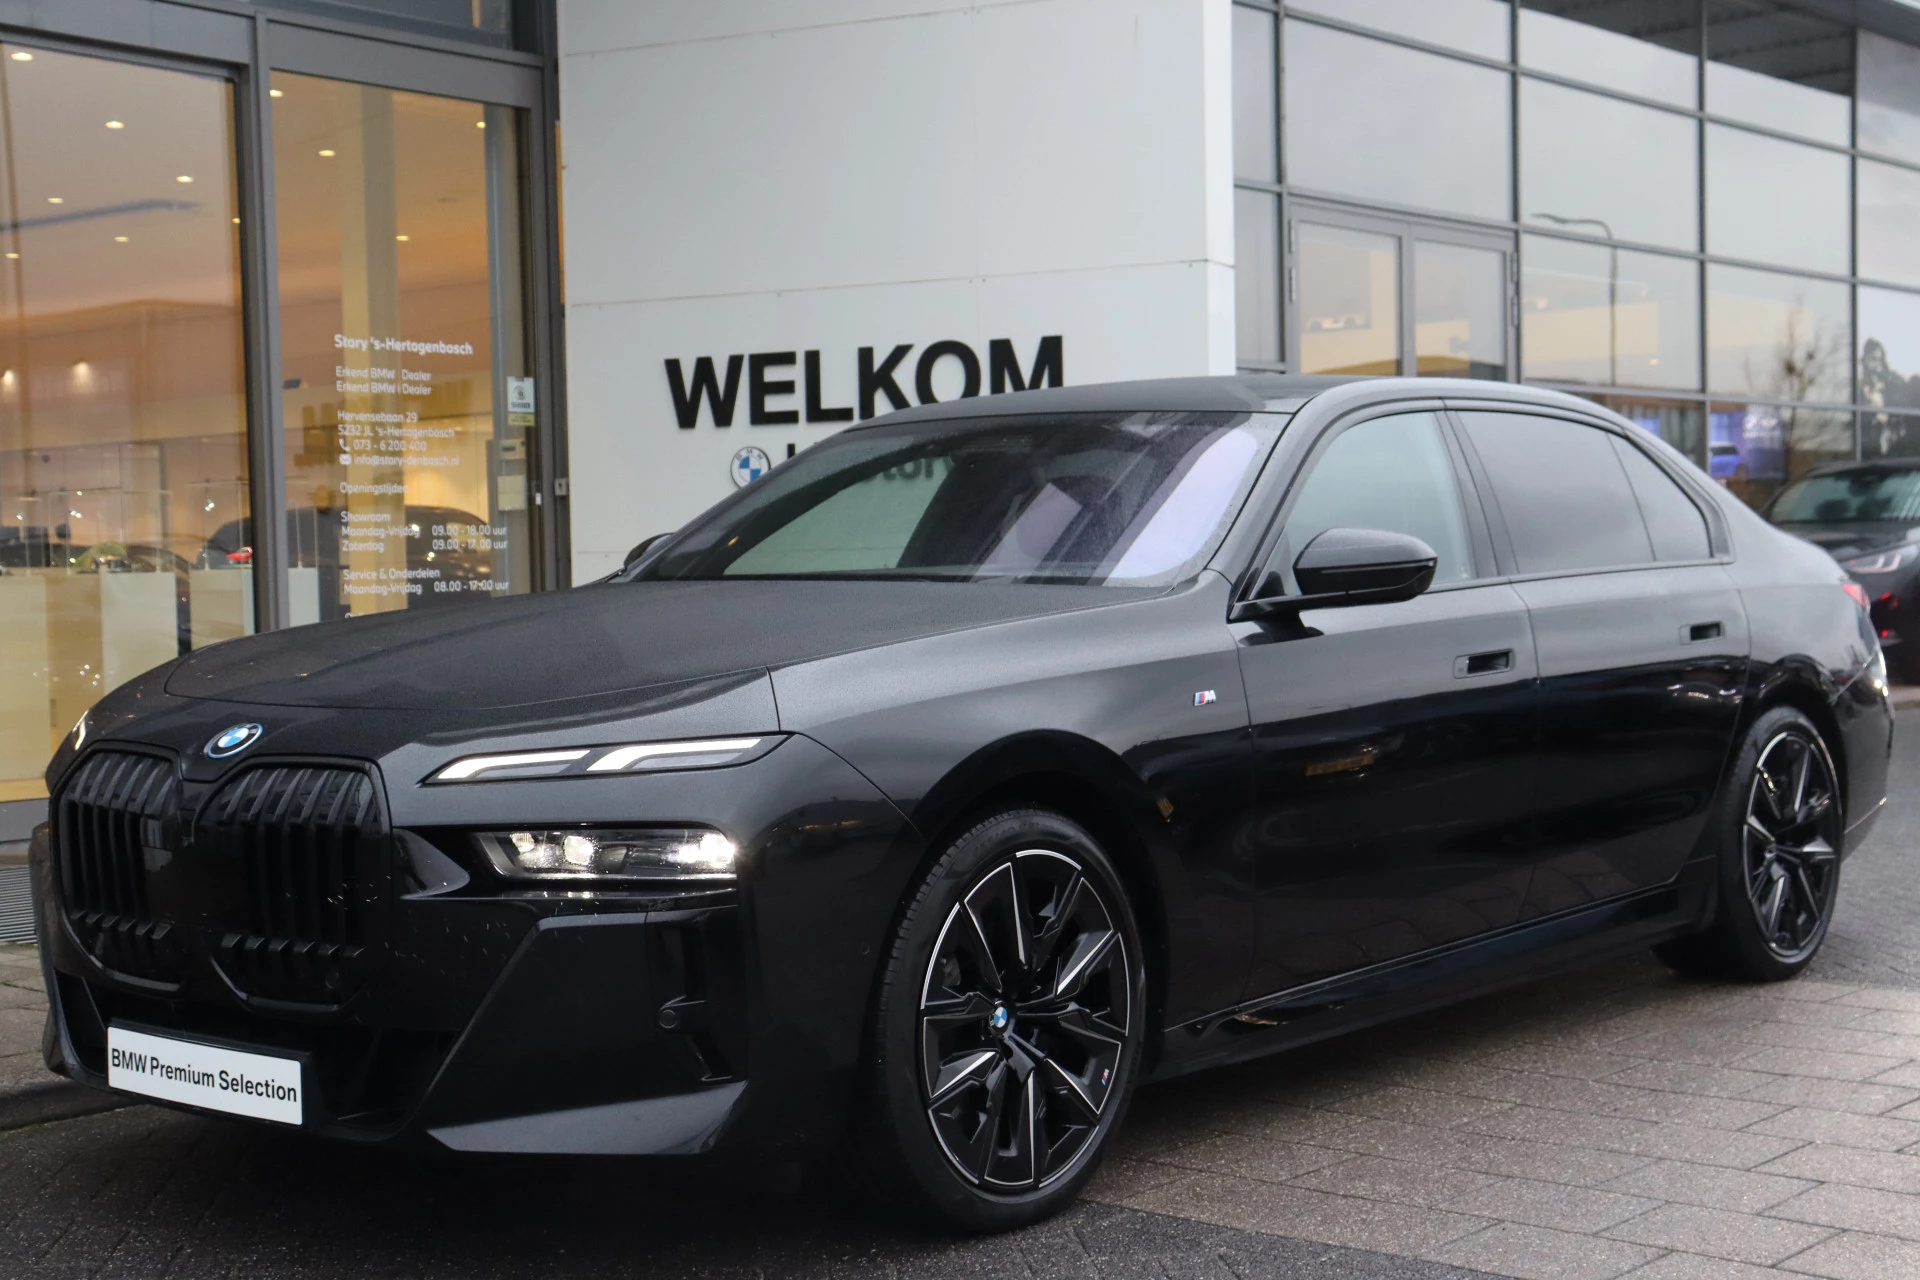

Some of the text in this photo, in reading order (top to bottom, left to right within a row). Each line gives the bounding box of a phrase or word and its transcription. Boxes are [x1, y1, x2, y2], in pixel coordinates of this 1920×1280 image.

[334, 333, 473, 356] Story 's-Hertogenbosch
[335, 365, 432, 381] Erkend BMW Dealer
[336, 380, 369, 393] Erkend
[371, 381, 396, 394] BMW
[402, 383, 432, 395] Dealer
[664, 335, 1064, 429] WELKOM
[337, 410, 418, 423] Hervensebaan 29
[338, 424, 361, 436] 5232
[353, 439, 371, 451] 073
[379, 439, 386, 451] 6
[387, 439, 406, 451] 200
[408, 440, 427, 451] 400
[339, 482, 409, 496] Openingstijden
[340, 511, 391, 523] Showroom
[341, 525, 421, 538] Maandag-Vrijdag
[431, 524, 459, 536] 09.00
[467, 524, 491, 536] 18.00
[492, 527, 508, 536] uur
[342, 540, 385, 553] Zaterdag
[432, 539, 459, 550] 09.00
[493, 541, 508, 550] uur
[343, 568, 440, 580] Service & Onderdelen
[343, 582, 423, 595] Maandag-Vrijdag
[434, 580, 461, 592] 08.00
[494, 582, 509, 591] uur
[111, 1047, 297, 1102] BMW Premium Selection
